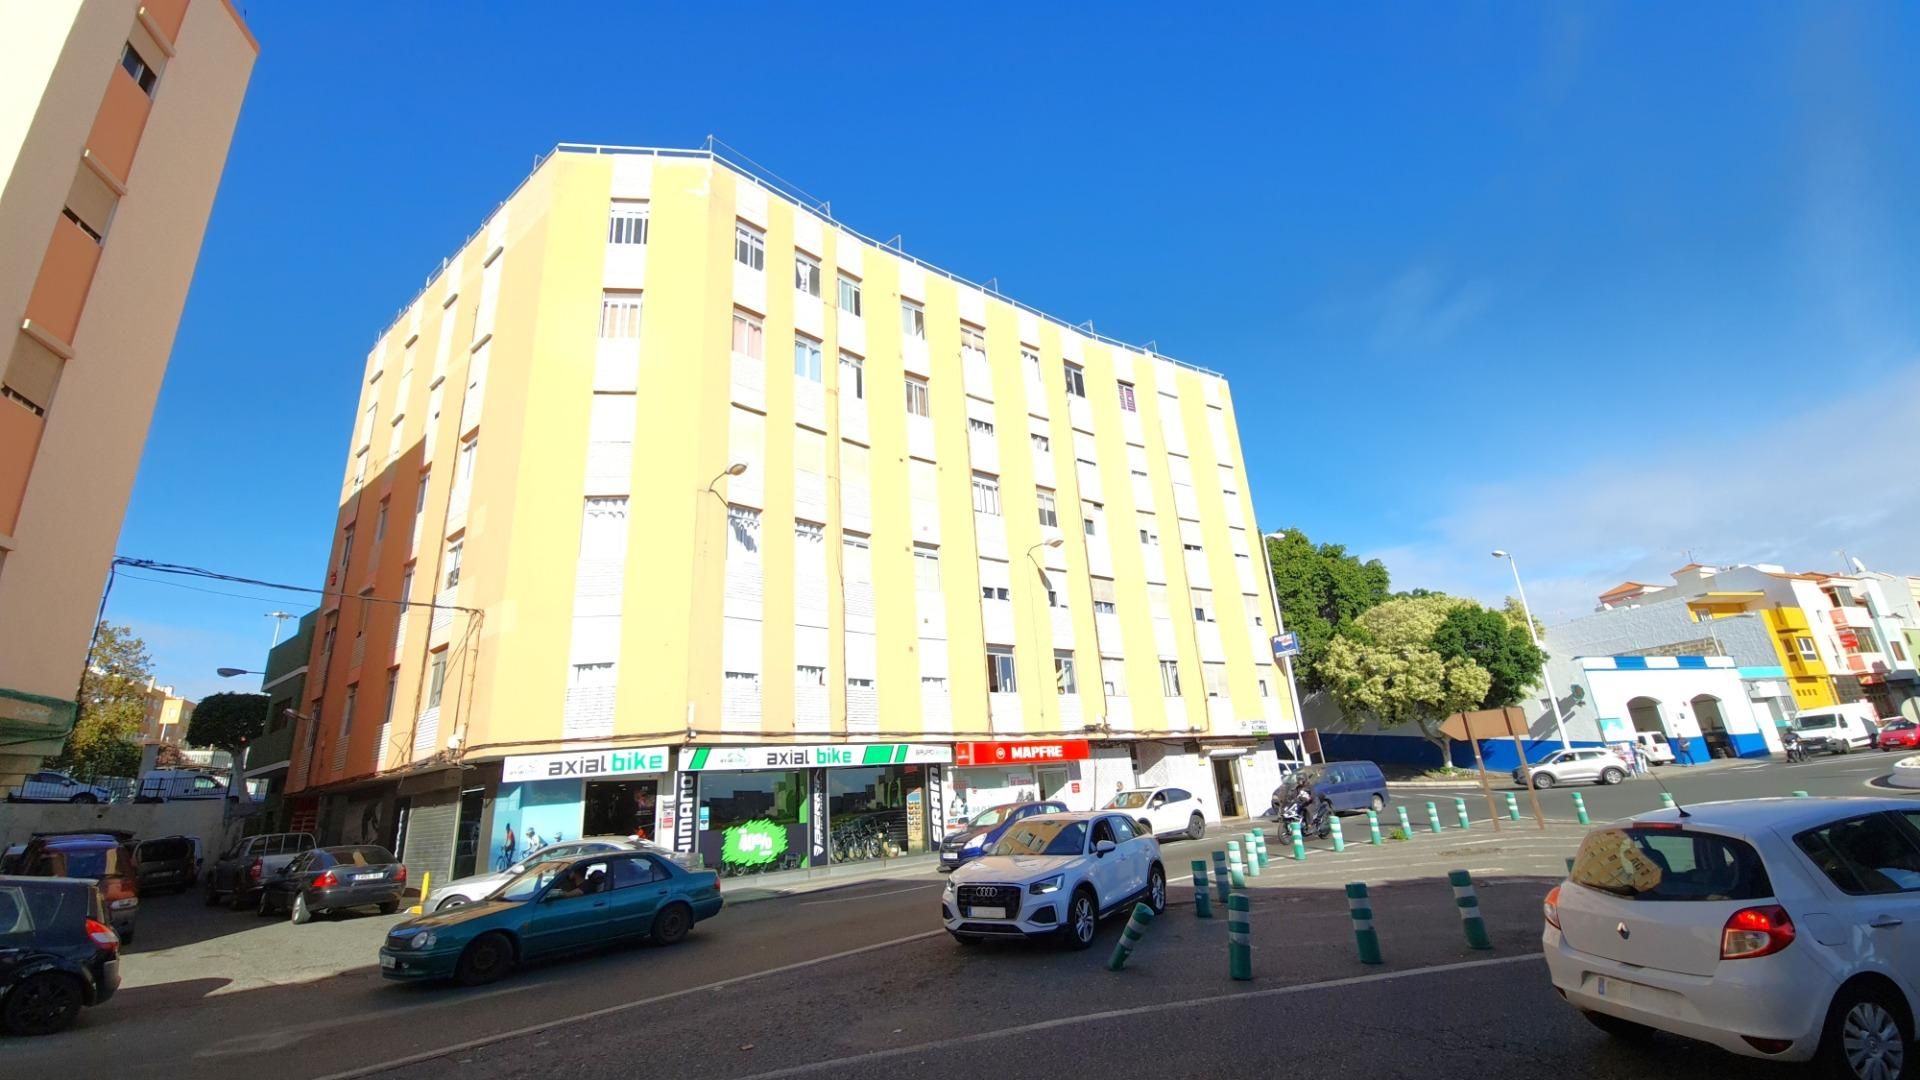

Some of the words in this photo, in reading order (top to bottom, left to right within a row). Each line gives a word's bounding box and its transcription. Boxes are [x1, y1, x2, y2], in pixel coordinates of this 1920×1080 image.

[767, 749, 810, 766] axial
[816, 747, 852, 764] bike
[1011, 745, 1063, 759] MAPFRE
[548, 755, 607, 776] axial
[611, 752, 663, 772] bike
[929, 766, 942, 843] SRAM
